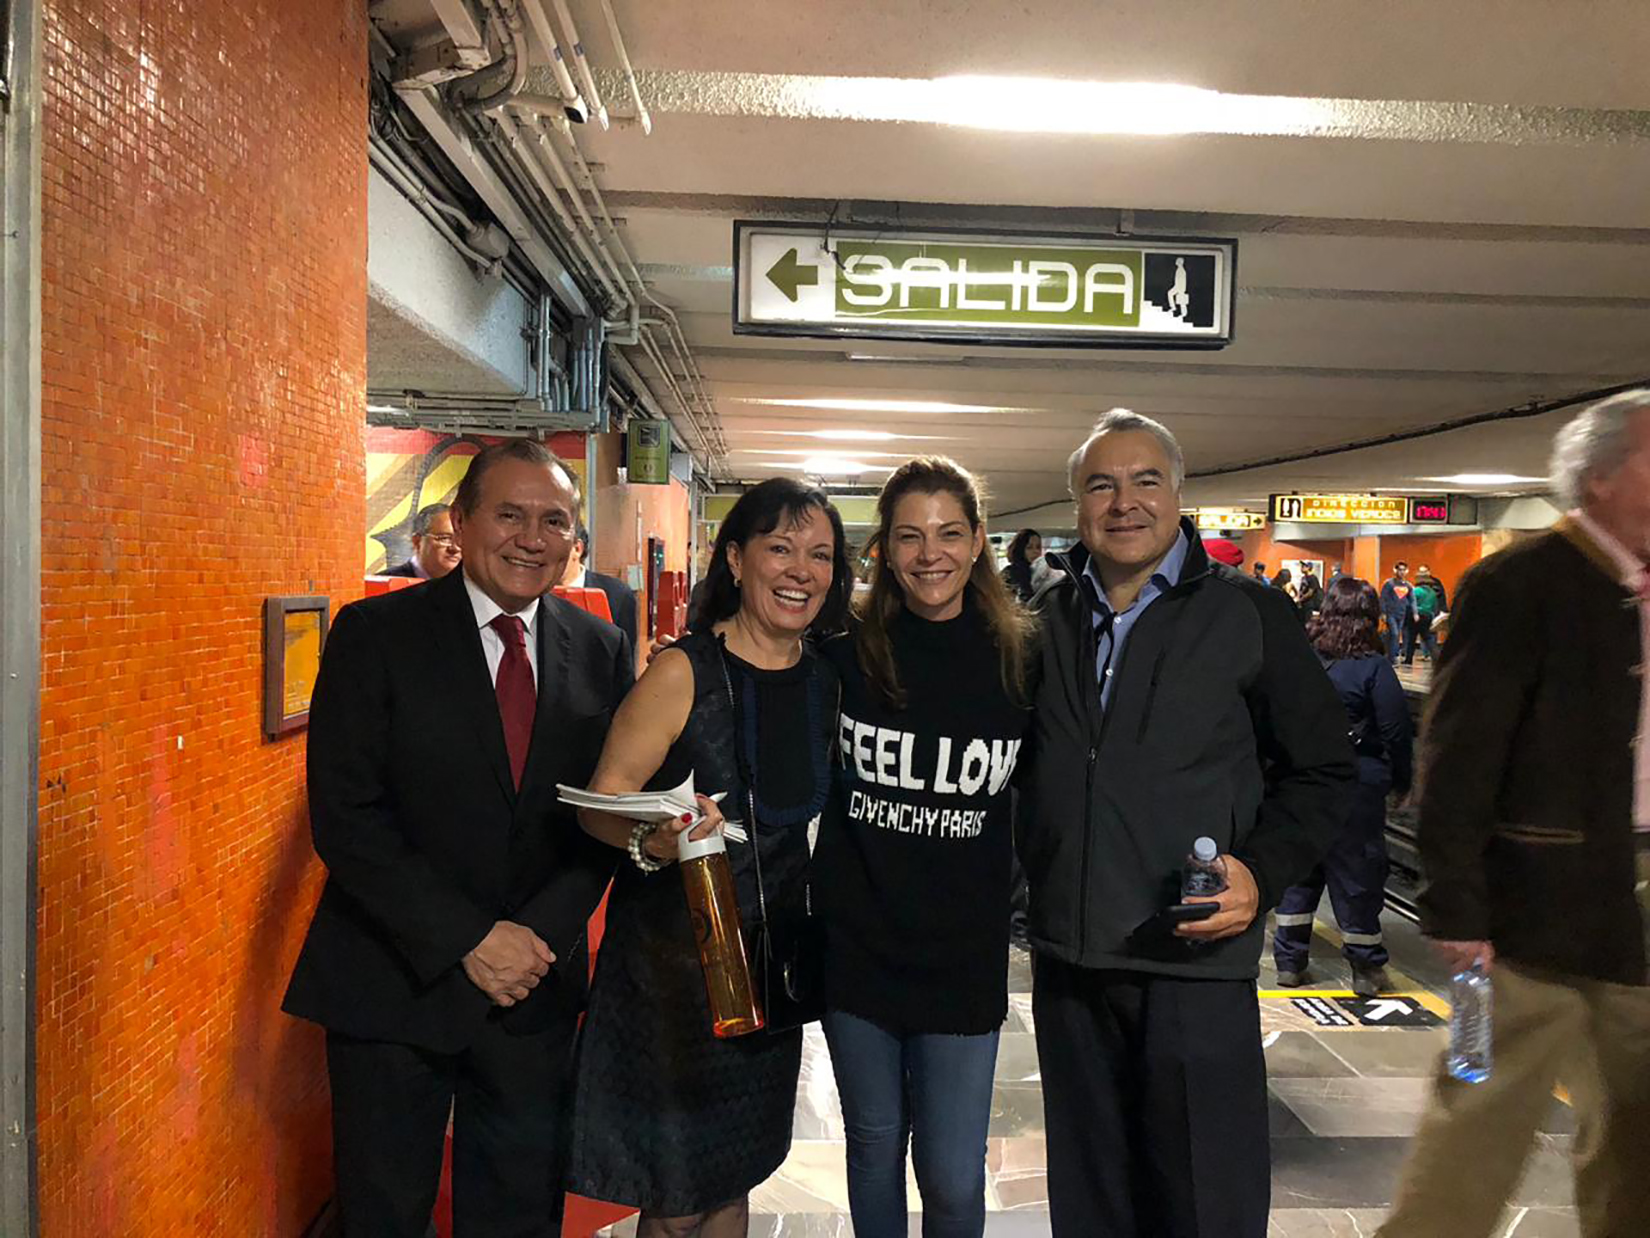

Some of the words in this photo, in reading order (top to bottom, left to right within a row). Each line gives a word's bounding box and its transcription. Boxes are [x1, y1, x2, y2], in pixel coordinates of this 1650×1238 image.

[841, 254, 1134, 315] SALIDA
[839, 712, 926, 791] FEEL
[848, 790, 939, 836] GIVENCHY
[940, 809, 987, 838] PARIS
